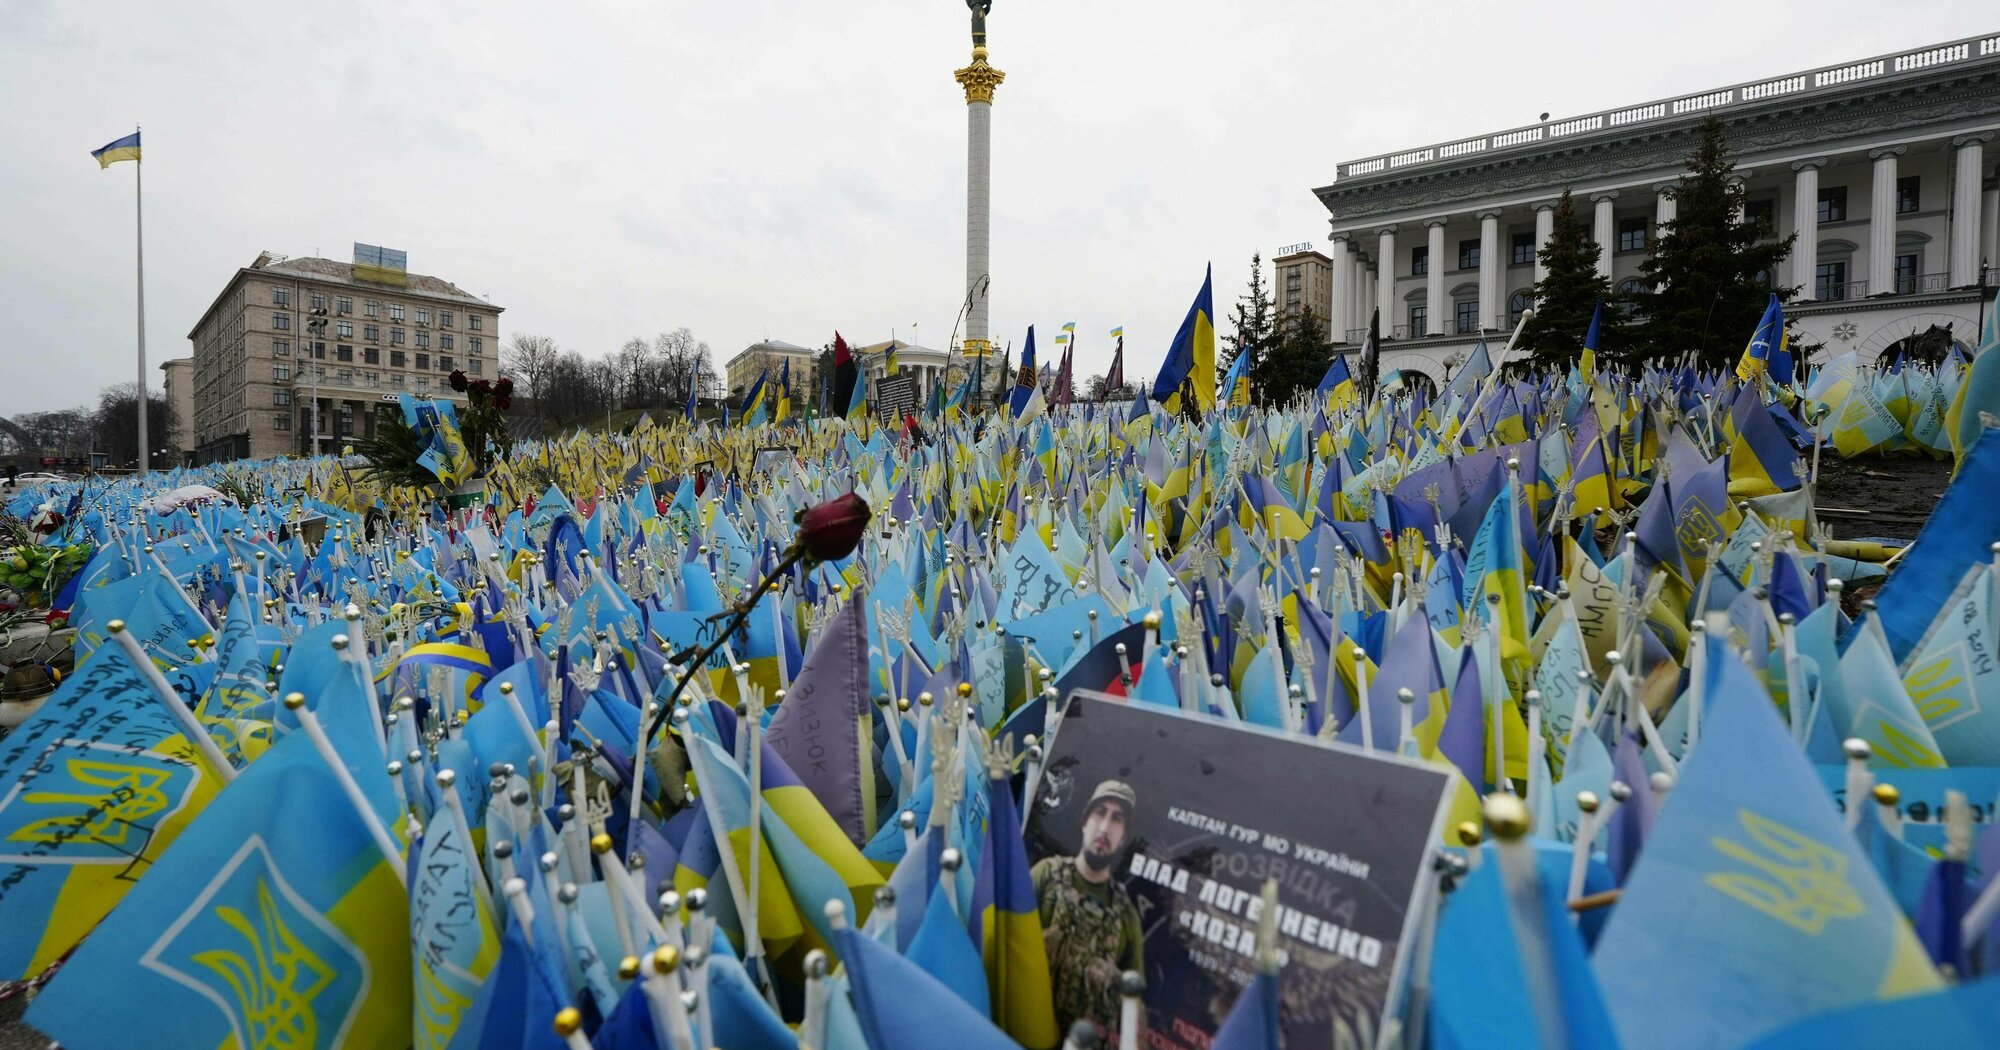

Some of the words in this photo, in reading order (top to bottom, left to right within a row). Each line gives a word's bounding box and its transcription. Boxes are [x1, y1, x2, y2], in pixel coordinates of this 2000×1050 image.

[1278, 241, 1313, 256] ГОТЕЛЬ
[1129, 852, 1190, 894] ВЛАД
[1167, 806, 1227, 836] КАПІТАН
[1229, 824, 1260, 844] ГУР
[1262, 834, 1290, 855] МО
[1295, 842, 1371, 880] УКРАЇНИ
[1211, 851, 1357, 923] РОЗВІДКА
[1178, 908, 1290, 968] «КОЗА»
